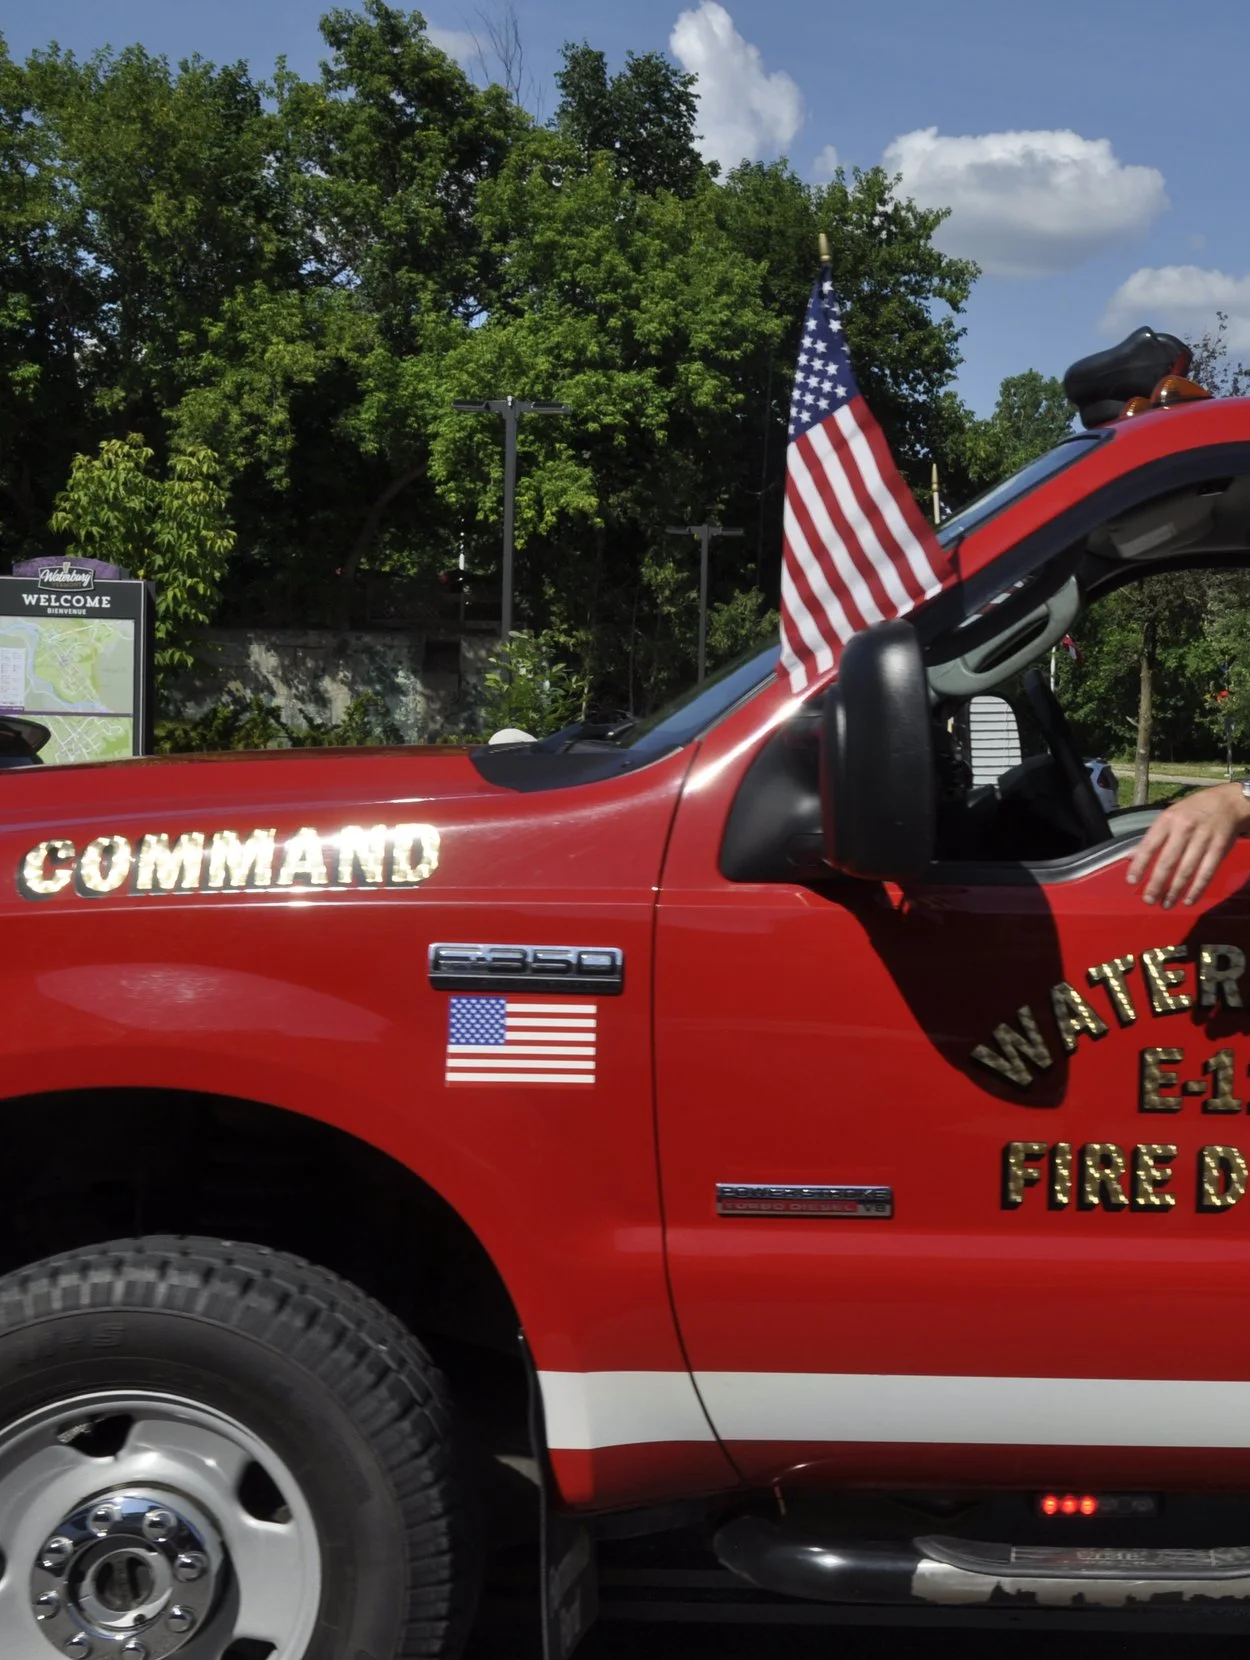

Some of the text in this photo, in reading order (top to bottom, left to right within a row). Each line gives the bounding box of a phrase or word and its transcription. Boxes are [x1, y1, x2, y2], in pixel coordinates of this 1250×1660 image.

[40, 569, 92, 588] Waterbury
[22, 594, 111, 608] WELCOME
[47, 607, 87, 615] BIENVENUE
[18, 822, 441, 899] COMMAND
[433, 946, 617, 975] F-350
[1001, 1140, 1178, 1213] FIRE
